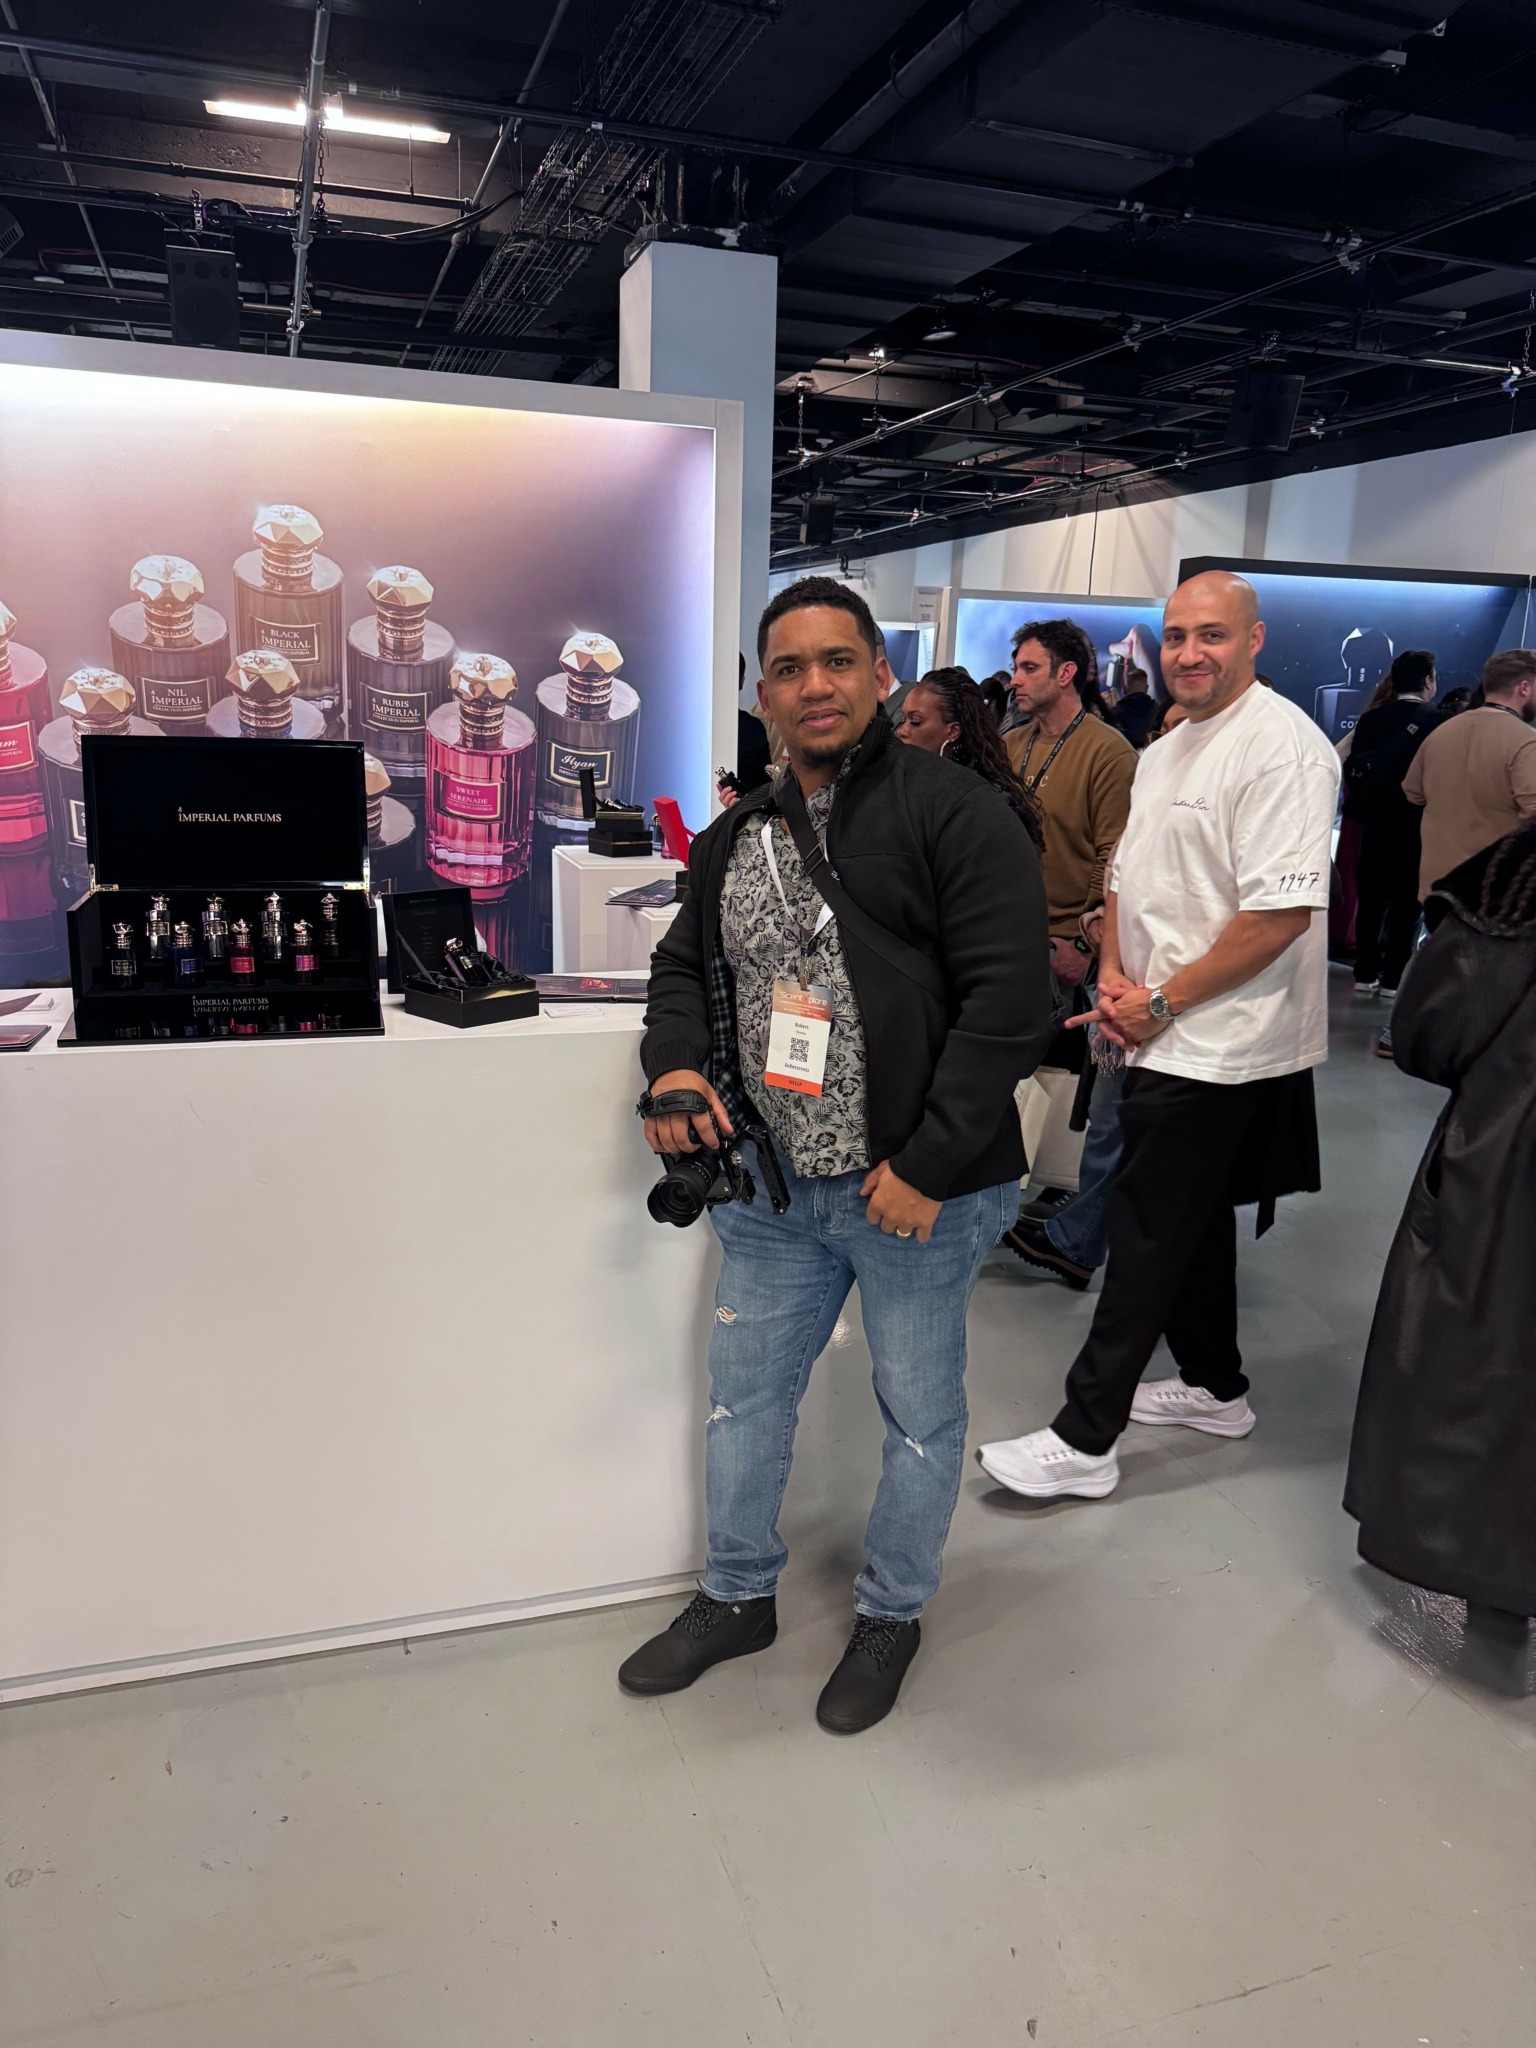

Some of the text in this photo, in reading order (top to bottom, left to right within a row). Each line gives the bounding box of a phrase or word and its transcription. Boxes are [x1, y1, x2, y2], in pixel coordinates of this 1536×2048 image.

[270, 628, 300, 639] BLACK
[261, 636, 311, 649] IMPERIAL
[167, 688, 187, 697] NIL
[152, 695, 203, 706] IMPERIAL
[382, 698, 409, 708] RUBIS
[152, 705, 184, 713] COLLECTION
[372, 703, 421, 717] IMPERIAL
[373, 713, 399, 723] COLLECTION
[558, 768, 580, 778] IMPERIAL
[456, 786, 481, 797] SWEET
[450, 792, 488, 805] SERENADE
[178, 813, 282, 823] IMPERIAL PARFUMS
[1279, 872, 1320, 892] 1947
[192, 997, 269, 1006] IMPERIAL PARFUMS
[780, 991, 828, 1006] ScentXplore
